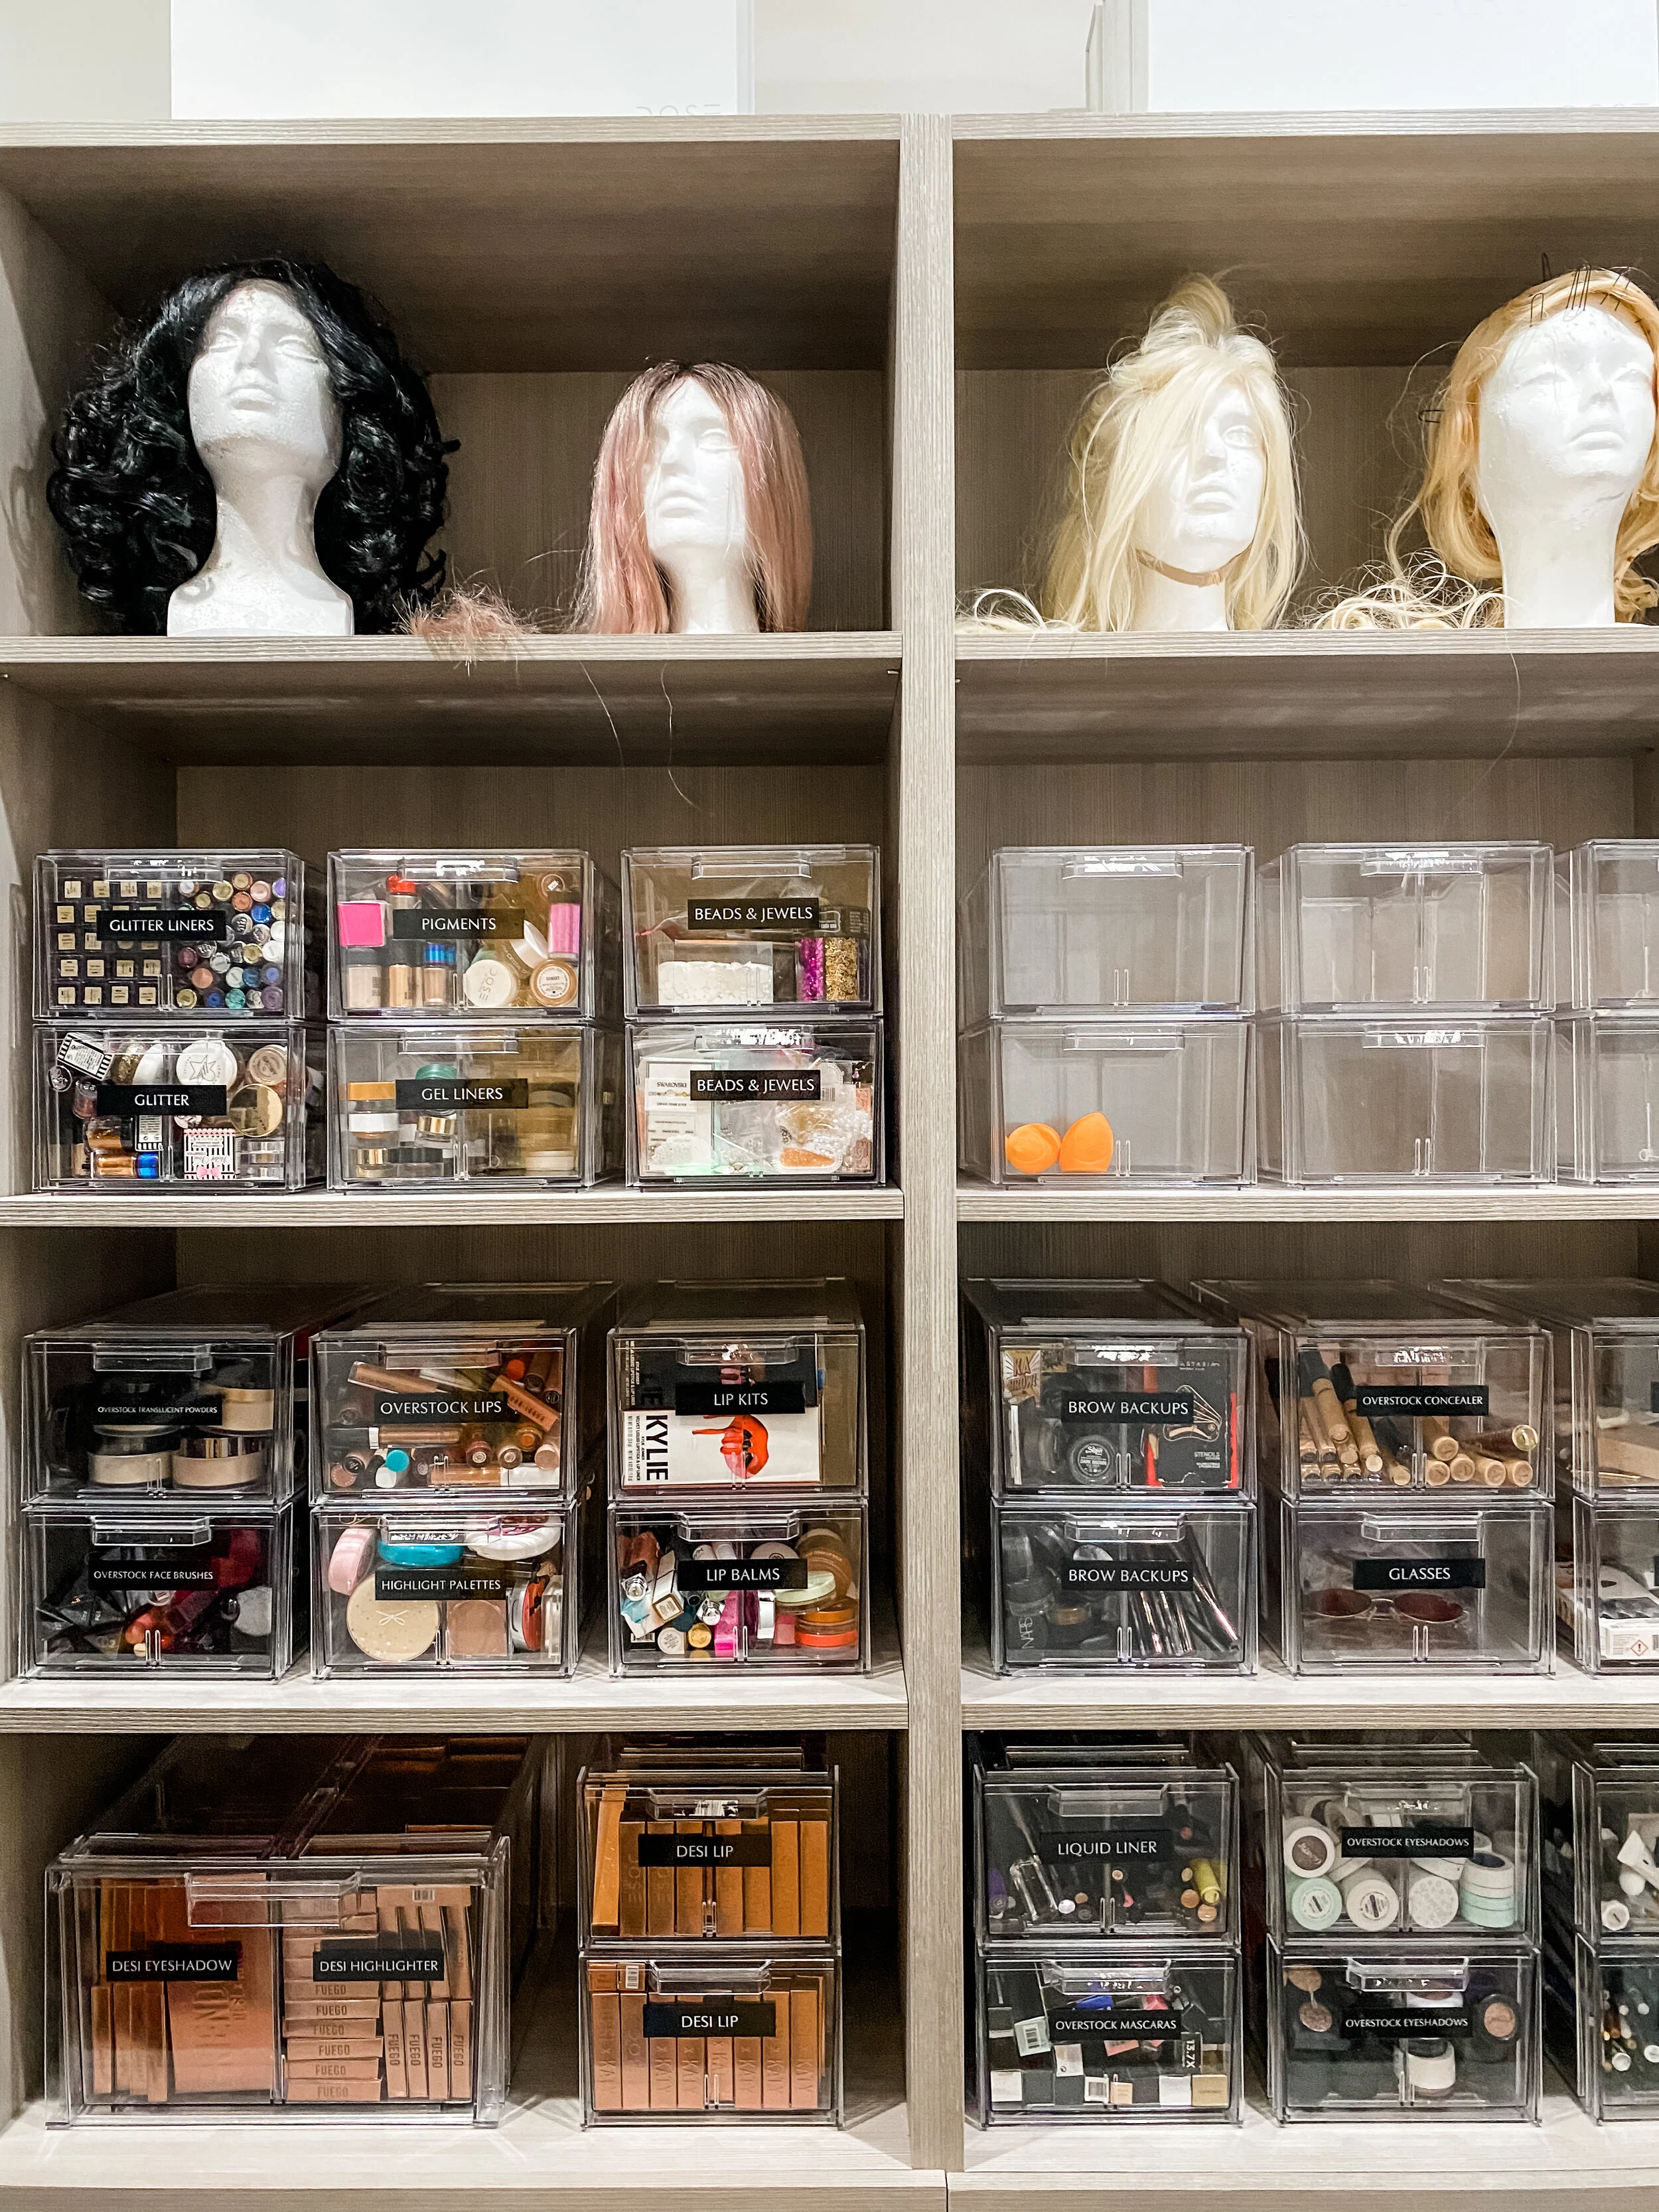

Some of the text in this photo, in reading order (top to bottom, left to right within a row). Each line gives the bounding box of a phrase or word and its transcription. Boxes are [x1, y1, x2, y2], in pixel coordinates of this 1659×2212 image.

[695, 907, 813, 922] BEADS & JEWELS
[109, 919, 214, 932] GLITTER LINERS
[421, 918, 496, 930] PIGMENTS
[697, 1078, 815, 1094] BEADS & JEWELS
[134, 1094, 190, 1106] GLITTER
[421, 1087, 503, 1100] GEL LINERS
[714, 1392, 768, 1406] LIP KITS
[1362, 1396, 1483, 1406] OVERSTOCK CONCEALER
[380, 1401, 469, 1414] OVERSTOCK
[474, 1400, 502, 1413] LIPS
[1068, 1401, 1189, 1415] BROW BACKUPS
[646, 1414, 669, 1481] KYLIE
[94, 1571, 213, 1580] OVERSTOCK FACE BRUSHES
[707, 1568, 780, 1582] LIP BALMS
[1069, 1569, 1189, 1582] BROW BACKUPS
[1389, 1568, 1451, 1580] GLASSES
[382, 1580, 501, 1590] HIGHLIGHT PALETTES
[1018, 1617, 1035, 1650] NARS
[1058, 1841, 1157, 1857] LIQUID LINER
[1347, 1838, 1469, 1847] OVERSTOCK EYESHADOWS
[677, 1845, 733, 1858] DESI LIP
[112, 1959, 232, 1972] DESI EYESHADOW
[320, 1960, 438, 1972] DESI HIGHLIGHTER
[315, 1984, 346, 1995] FUEGO
[316, 2005, 348, 2016] FUEGO
[682, 2015, 739, 2028] DESI LIP
[1055, 2020, 1177, 2030] OVERSTOCK MASCARAS
[1345, 2018, 1468, 2028] OVERSTOCK EYESHADOWS
[313, 2024, 344, 2035] FUEGO
[319, 2045, 350, 2055] FUEGO
[388, 2033, 401, 2066] FUEGO
[409, 2033, 421, 2066] FUEGO
[430, 2035, 443, 2069] FUEGO
[453, 2033, 465, 2067] FUEGO
[315, 2065, 346, 2075] FUEGO
[317, 2086, 348, 2097] FUEGO
